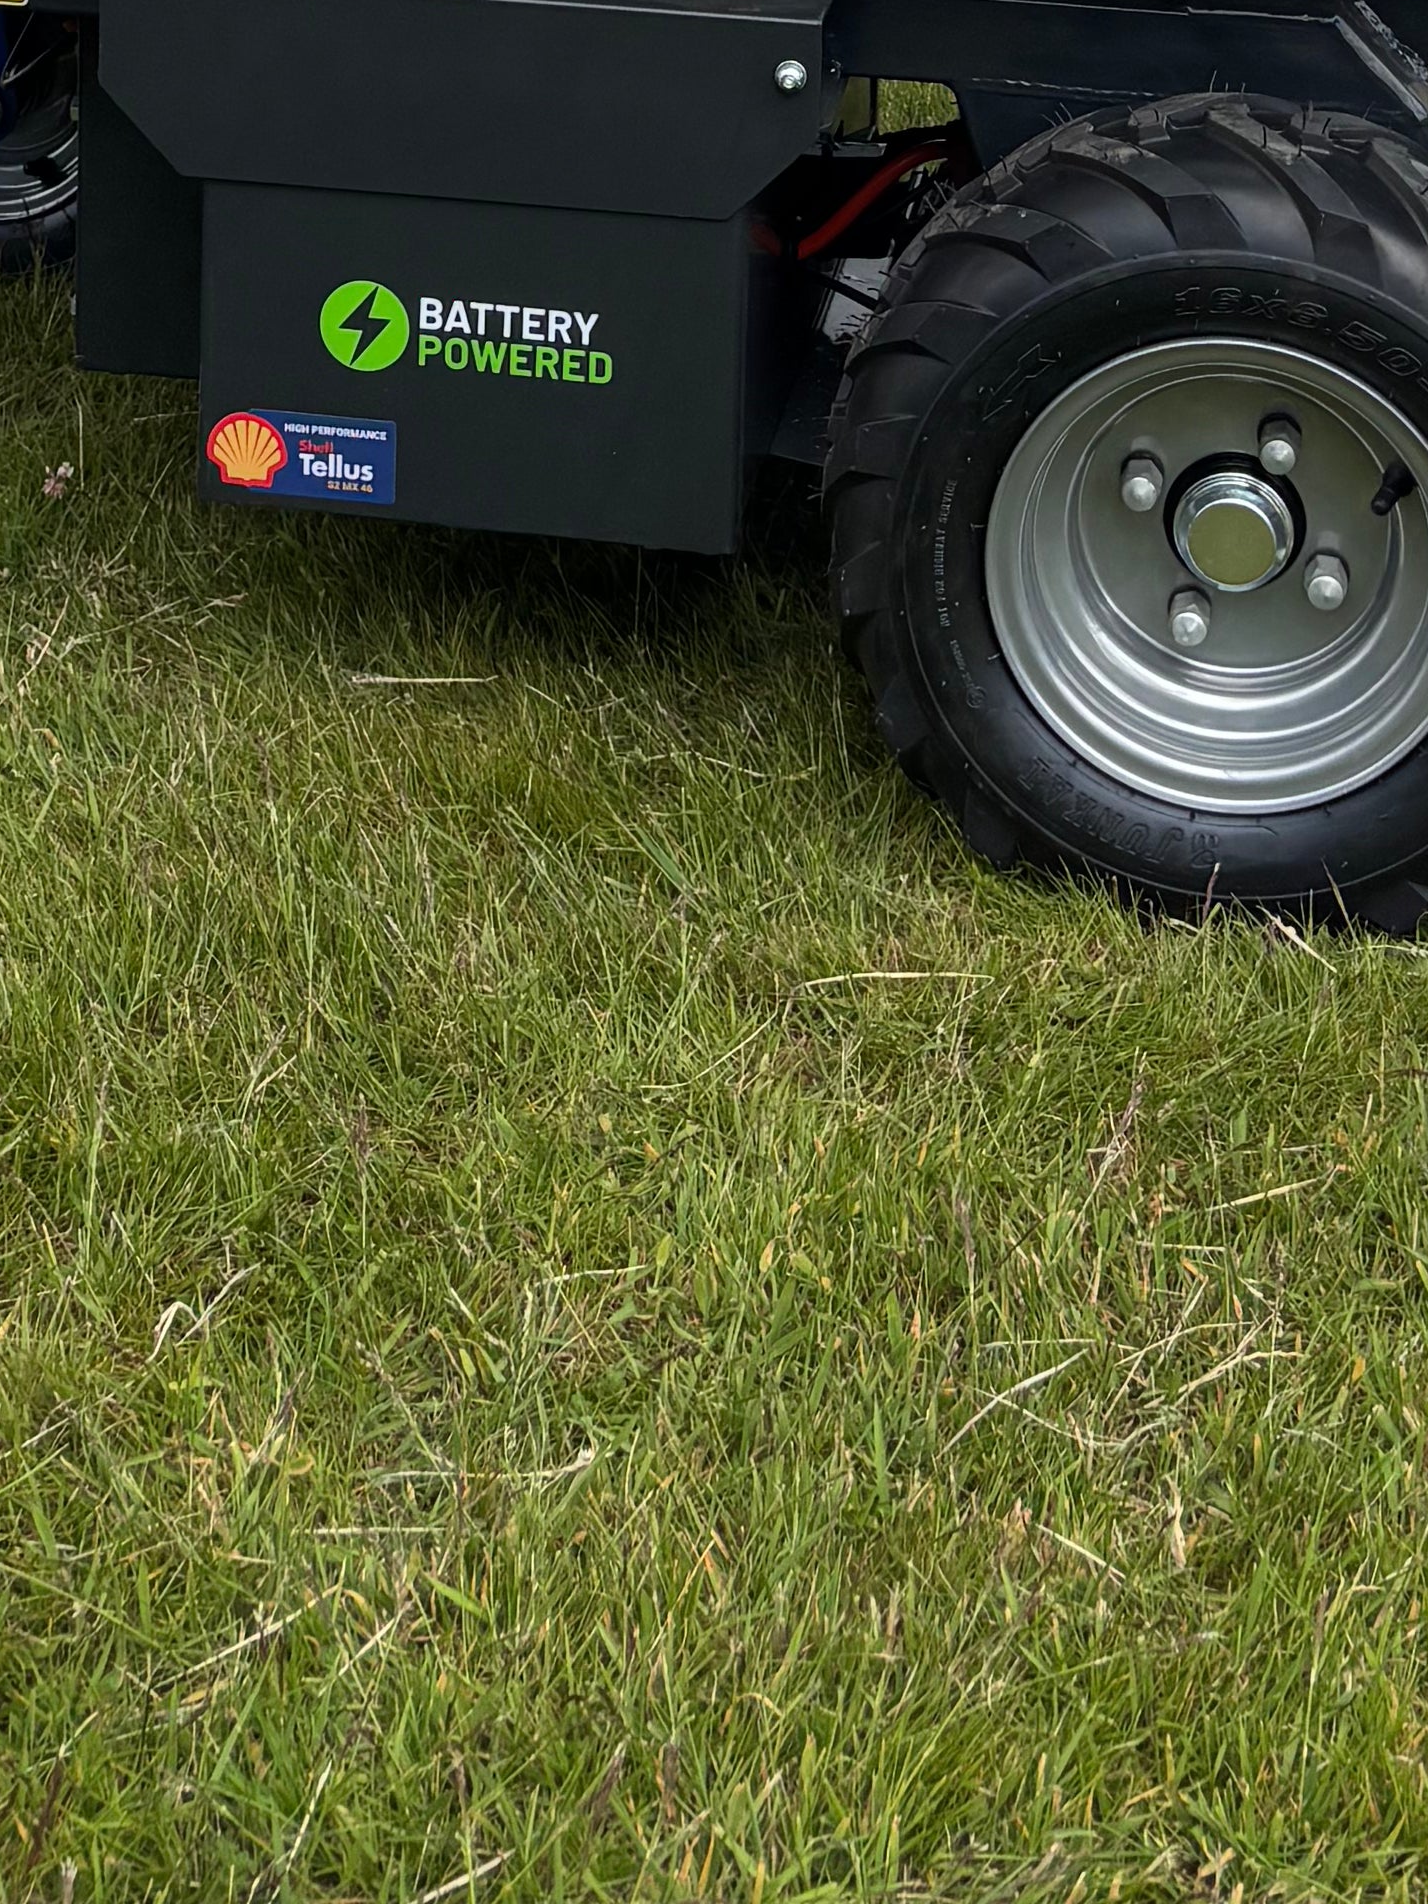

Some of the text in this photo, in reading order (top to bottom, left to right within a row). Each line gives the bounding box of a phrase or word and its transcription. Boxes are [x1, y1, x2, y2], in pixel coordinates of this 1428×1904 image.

[419, 296, 600, 346] BATTERY
[418, 334, 614, 385] POWERED
[284, 422, 387, 441] HIGH PERFORMANCE
[298, 439, 334, 453] Shell
[298, 453, 374, 482] Tellus
